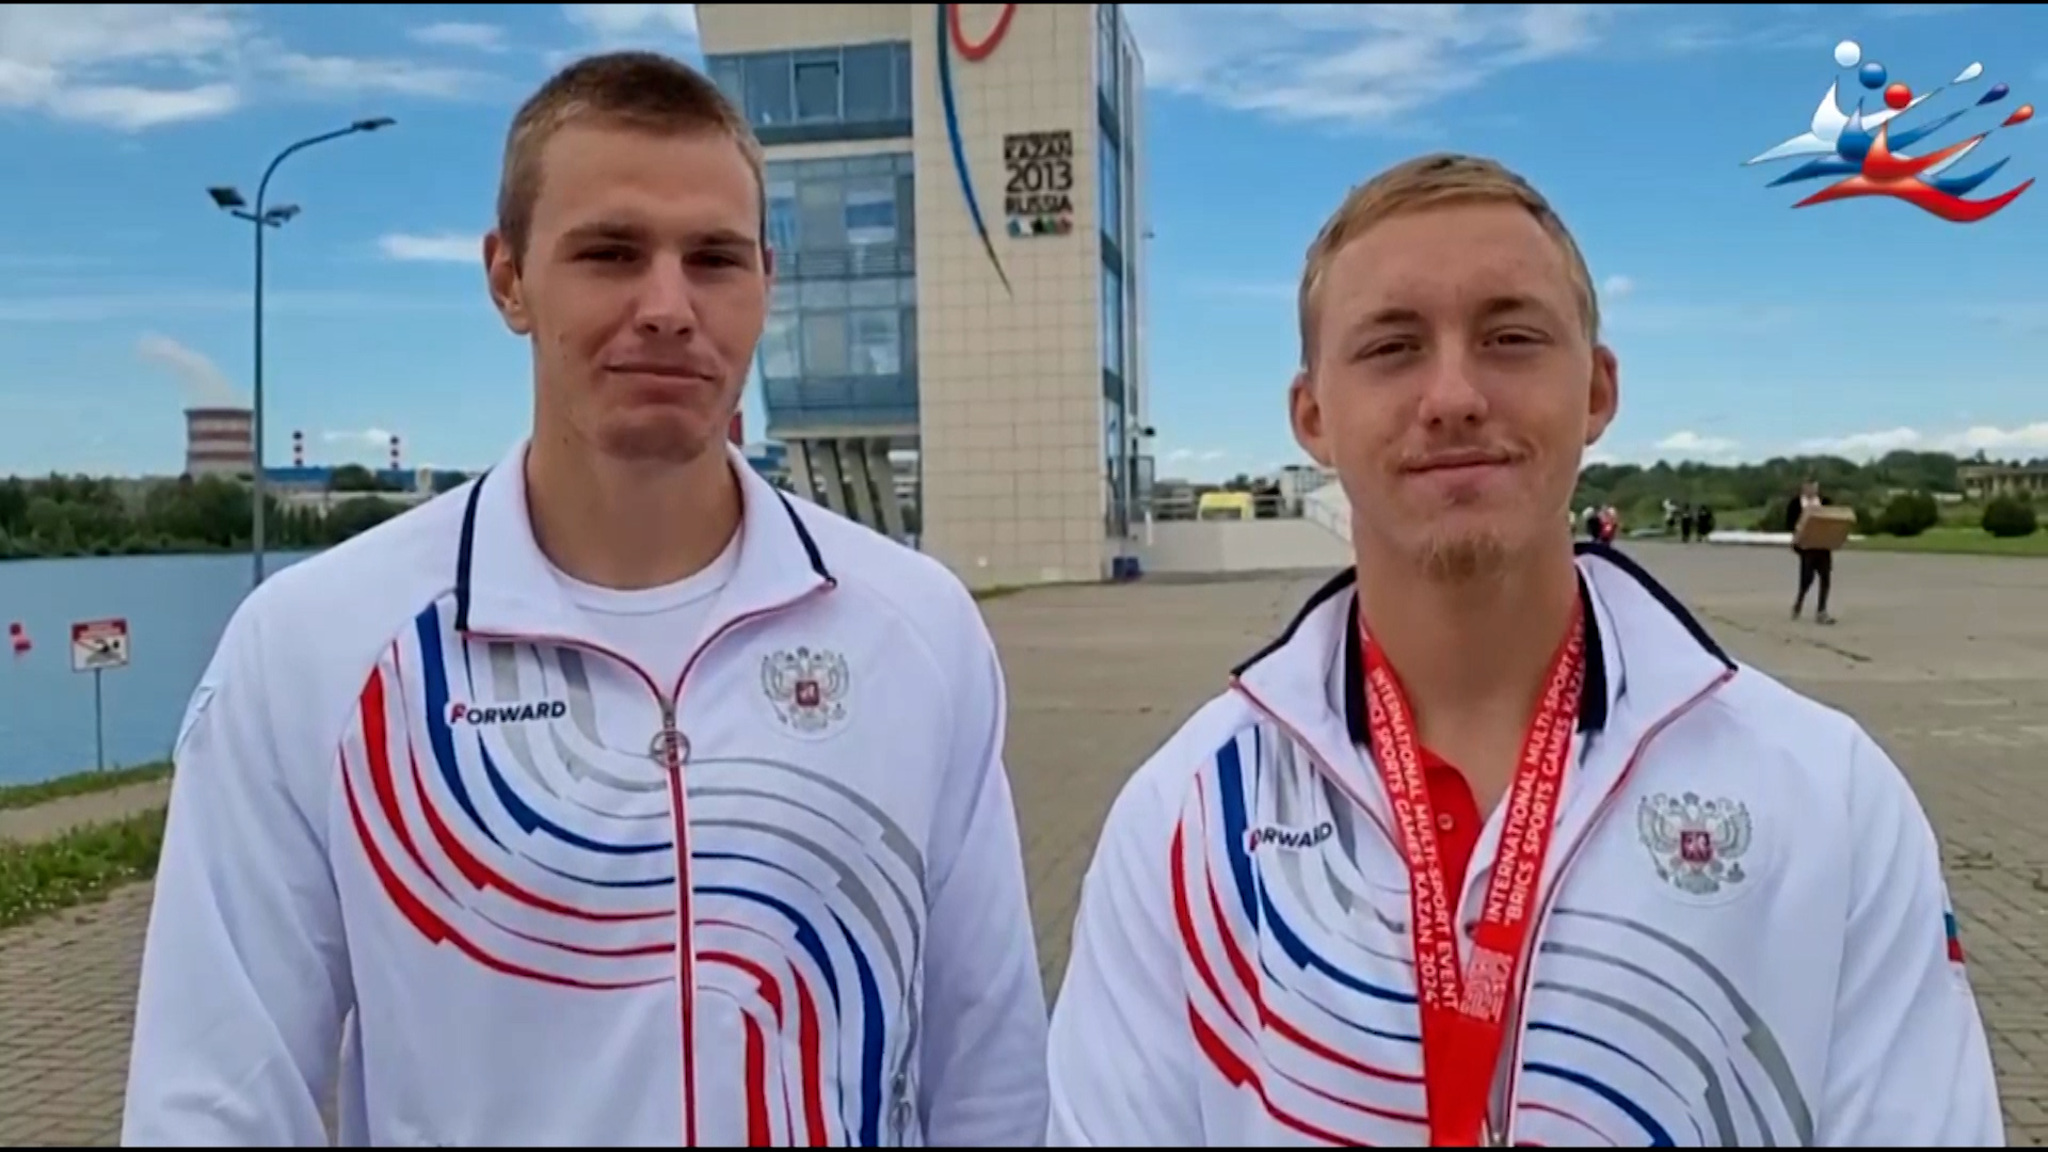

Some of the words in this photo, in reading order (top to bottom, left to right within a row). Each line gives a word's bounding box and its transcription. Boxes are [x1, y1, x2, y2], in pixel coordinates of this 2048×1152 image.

[1006, 161, 1073, 193] 2013
[450, 701, 567, 725] FORWARD
[1371, 666, 1423, 801] INTERNATIONAL
[1436, 941, 1460, 1010] EVENT
[1374, 726, 1407, 794] SPORTS
[1394, 798, 1425, 866] GAMES
[1414, 871, 1434, 945] KAZAN
[1486, 768, 1538, 923] INTERNATIONAL
[1522, 781, 1555, 857] SPORTS
[1541, 717, 1571, 776] GAMES
